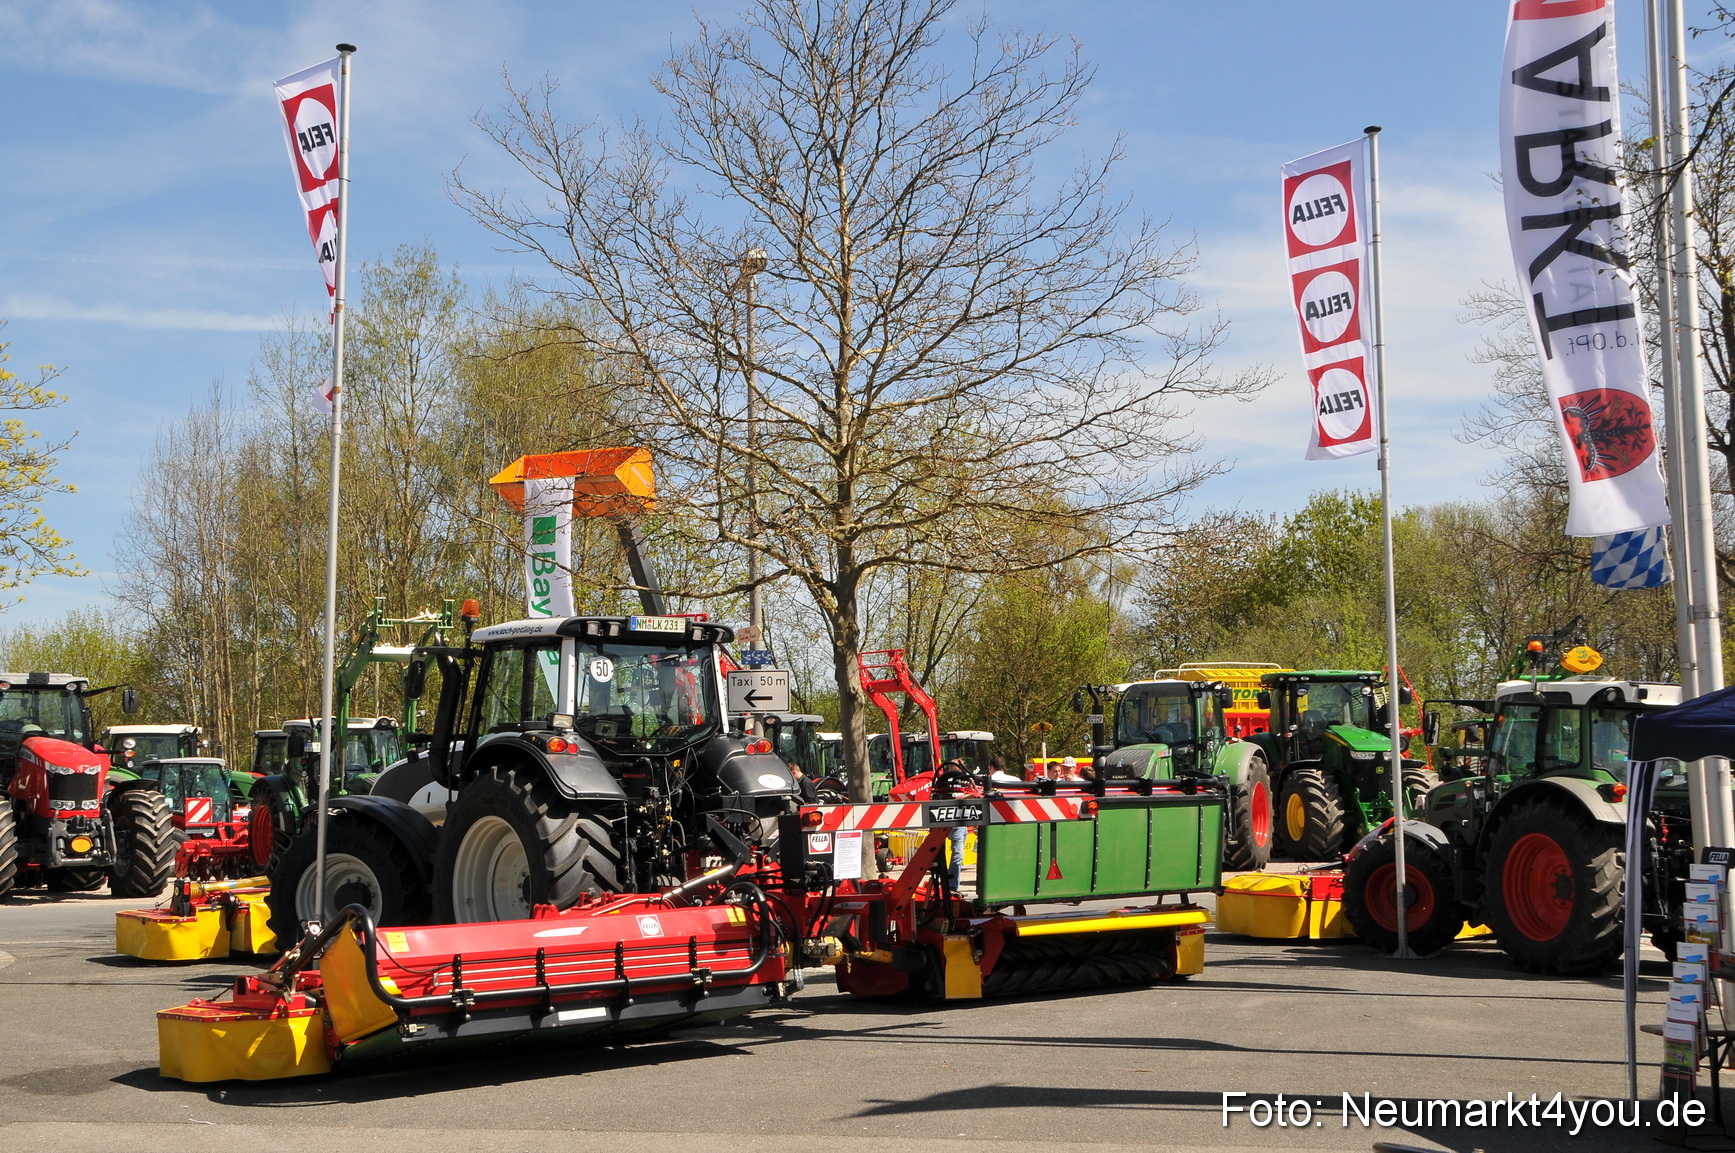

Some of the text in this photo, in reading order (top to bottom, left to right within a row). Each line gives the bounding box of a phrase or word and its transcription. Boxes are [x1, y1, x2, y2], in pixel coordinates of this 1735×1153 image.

[531, 551, 557, 617] Bay
[636, 619, 647, 630] NM
[652, 620, 663, 630] LK
[596, 662, 609, 677] 50
[731, 676, 786, 686] Taxi 50 m
[936, 805, 980, 821] FELLA
[811, 835, 828, 843] FELLA
[1709, 852, 1729, 862] FELLA
